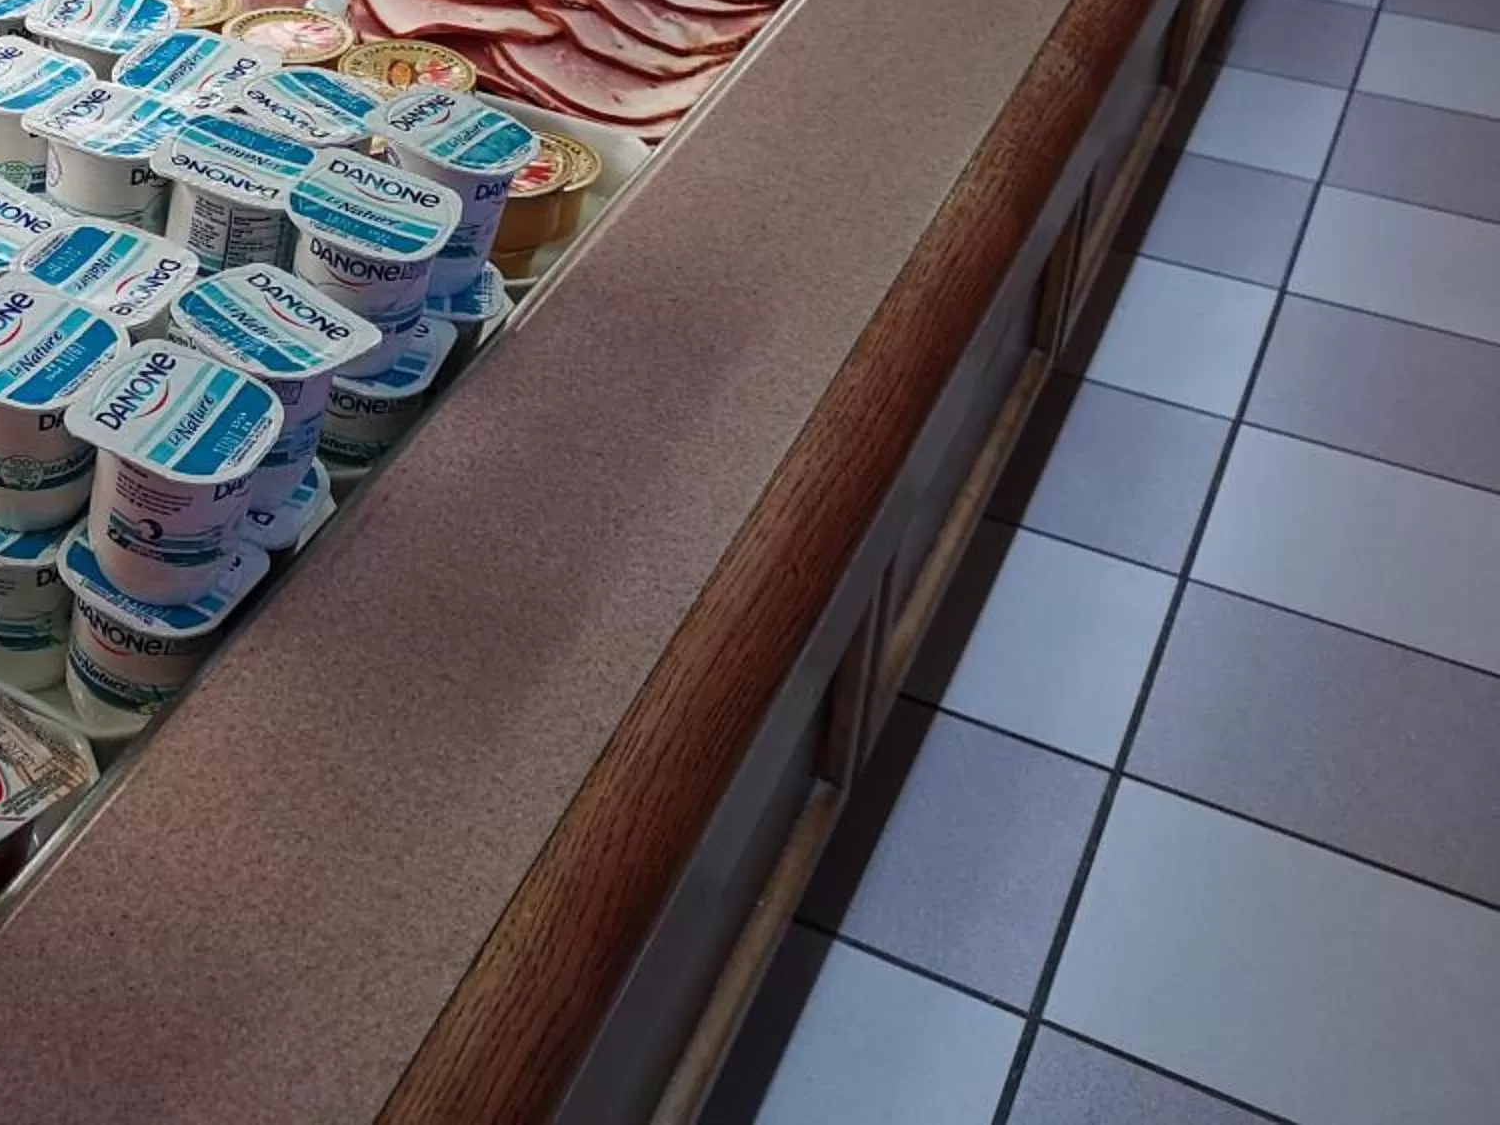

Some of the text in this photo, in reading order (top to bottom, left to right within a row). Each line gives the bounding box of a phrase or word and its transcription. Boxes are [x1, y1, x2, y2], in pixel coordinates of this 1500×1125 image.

[328, 158, 441, 209] DANONE
[475, 181, 510, 202] DAN
[247, 271, 350, 343] DANONE
[20, 330, 64, 376] Nature
[95, 351, 177, 432] DANONE
[179, 393, 216, 443] Nature
